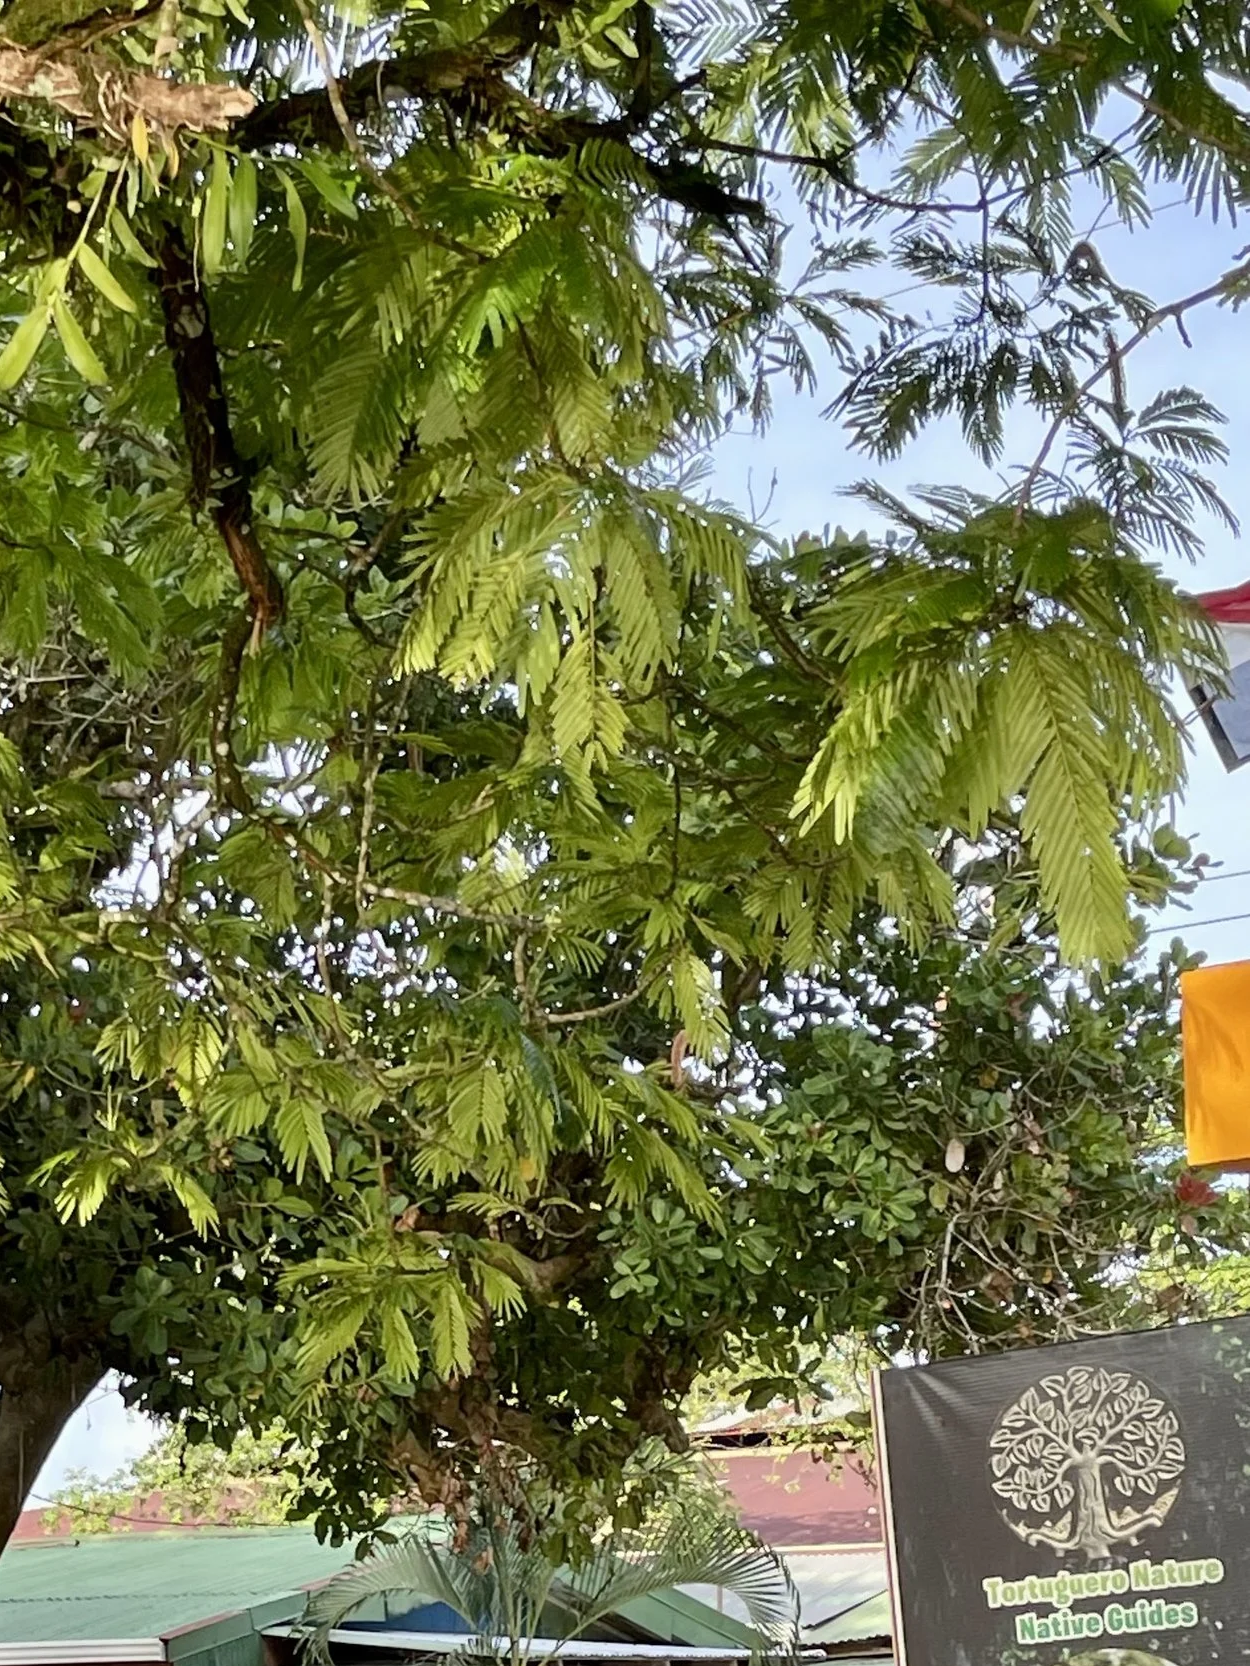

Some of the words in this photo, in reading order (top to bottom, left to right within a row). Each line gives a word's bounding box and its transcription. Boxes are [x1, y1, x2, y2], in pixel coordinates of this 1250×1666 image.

[983, 1570, 1129, 1608] Tortuguero
[1130, 1559, 1224, 1591] Nature
[1015, 1609, 1103, 1644] Native
[1104, 1599, 1198, 1634] Guides
